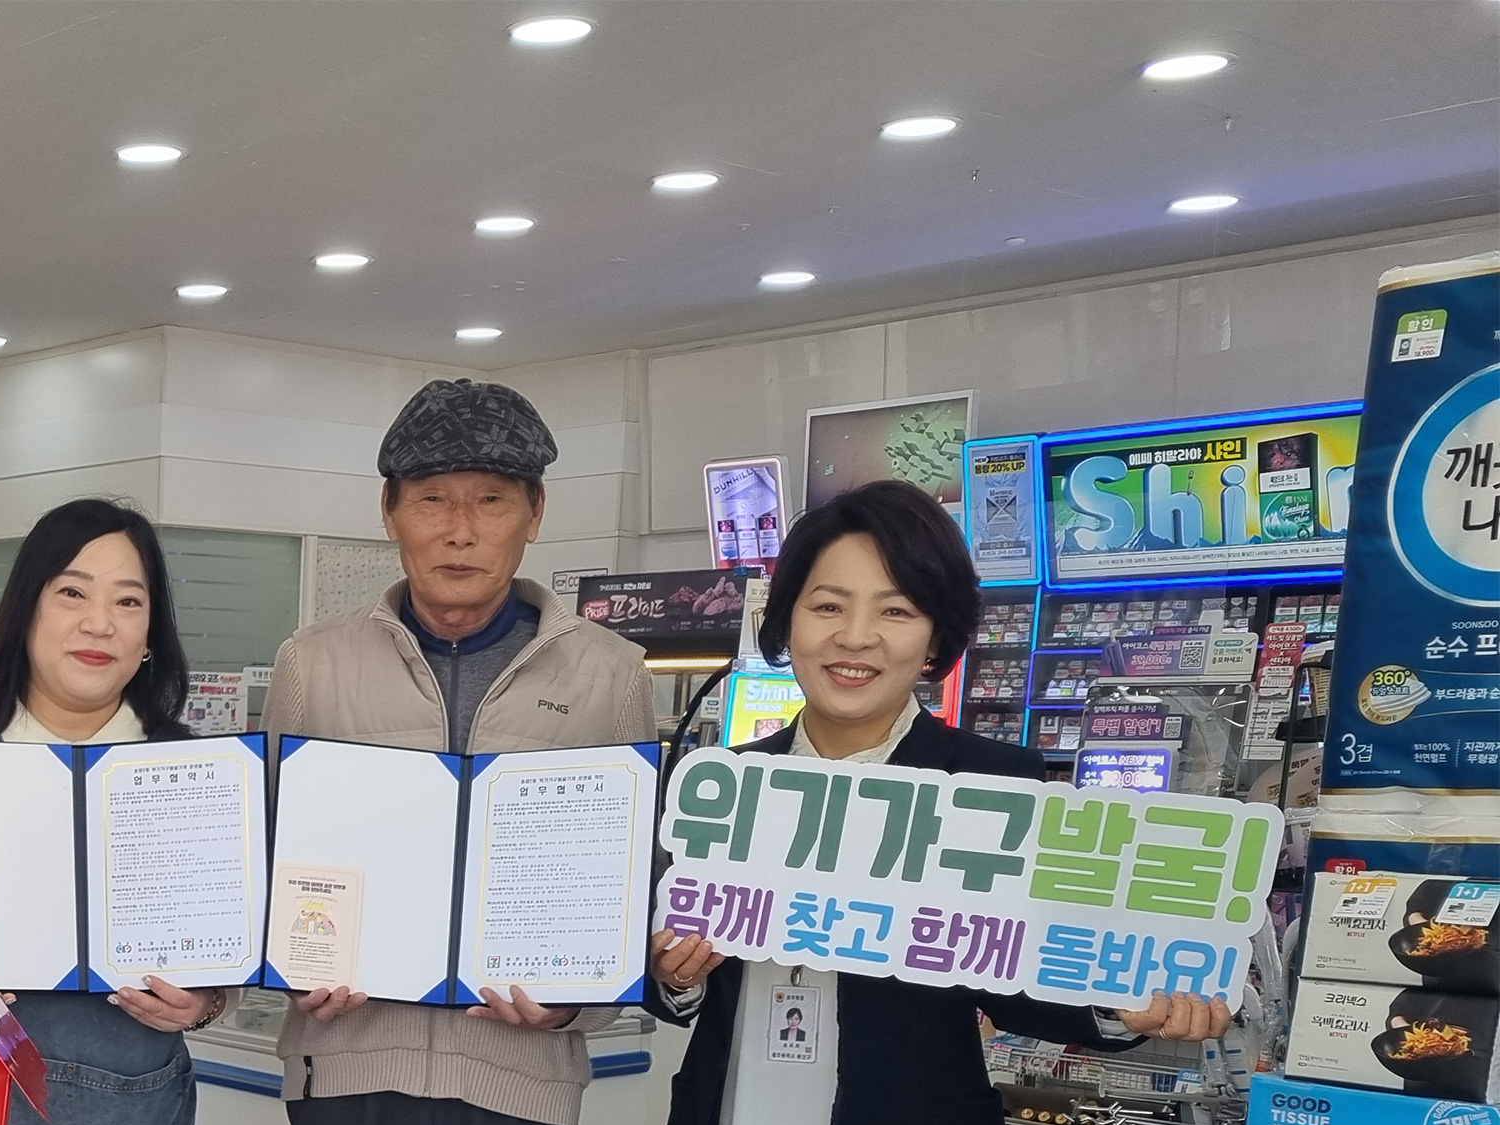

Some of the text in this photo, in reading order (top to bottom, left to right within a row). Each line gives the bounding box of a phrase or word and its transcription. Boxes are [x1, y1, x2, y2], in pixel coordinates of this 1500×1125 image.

[1408, 318, 1434, 332] 할인
[1154, 448, 1202, 463] 히말라야
[1203, 440, 1242, 462] 샤인
[991, 461, 1025, 473] 20% UP
[1444, 443, 1500, 489] 깨
[713, 468, 754, 494] DUNHILL
[585, 605, 609, 620] PRIDE
[608, 594, 666, 623] 프라이드
[1452, 620, 1499, 629] SOONSOO
[1425, 635, 1469, 659] 순수
[1373, 670, 1411, 686] 360°
[745, 679, 805, 701] Shine
[1435, 688, 1488, 700] 부드러움과
[537, 699, 570, 716] PING
[1092, 718, 1120, 736] 특별
[1340, 733, 1373, 765] 3겹
[1414, 753, 1448, 763] 천연펄프
[1467, 754, 1498, 764] 무형광
[671, 760, 1271, 924] 위기가구발굴!
[1350, 881, 1372, 893] 1+1
[1456, 886, 1480, 898] 1+1
[663, 877, 1239, 1001] 함께 찾고 함께 돌봐요!
[1324, 993, 1367, 1007] 크리넥스
[1311, 1015, 1371, 1033] 흑백요리사
[1271, 1093, 1332, 1115] GOOD
